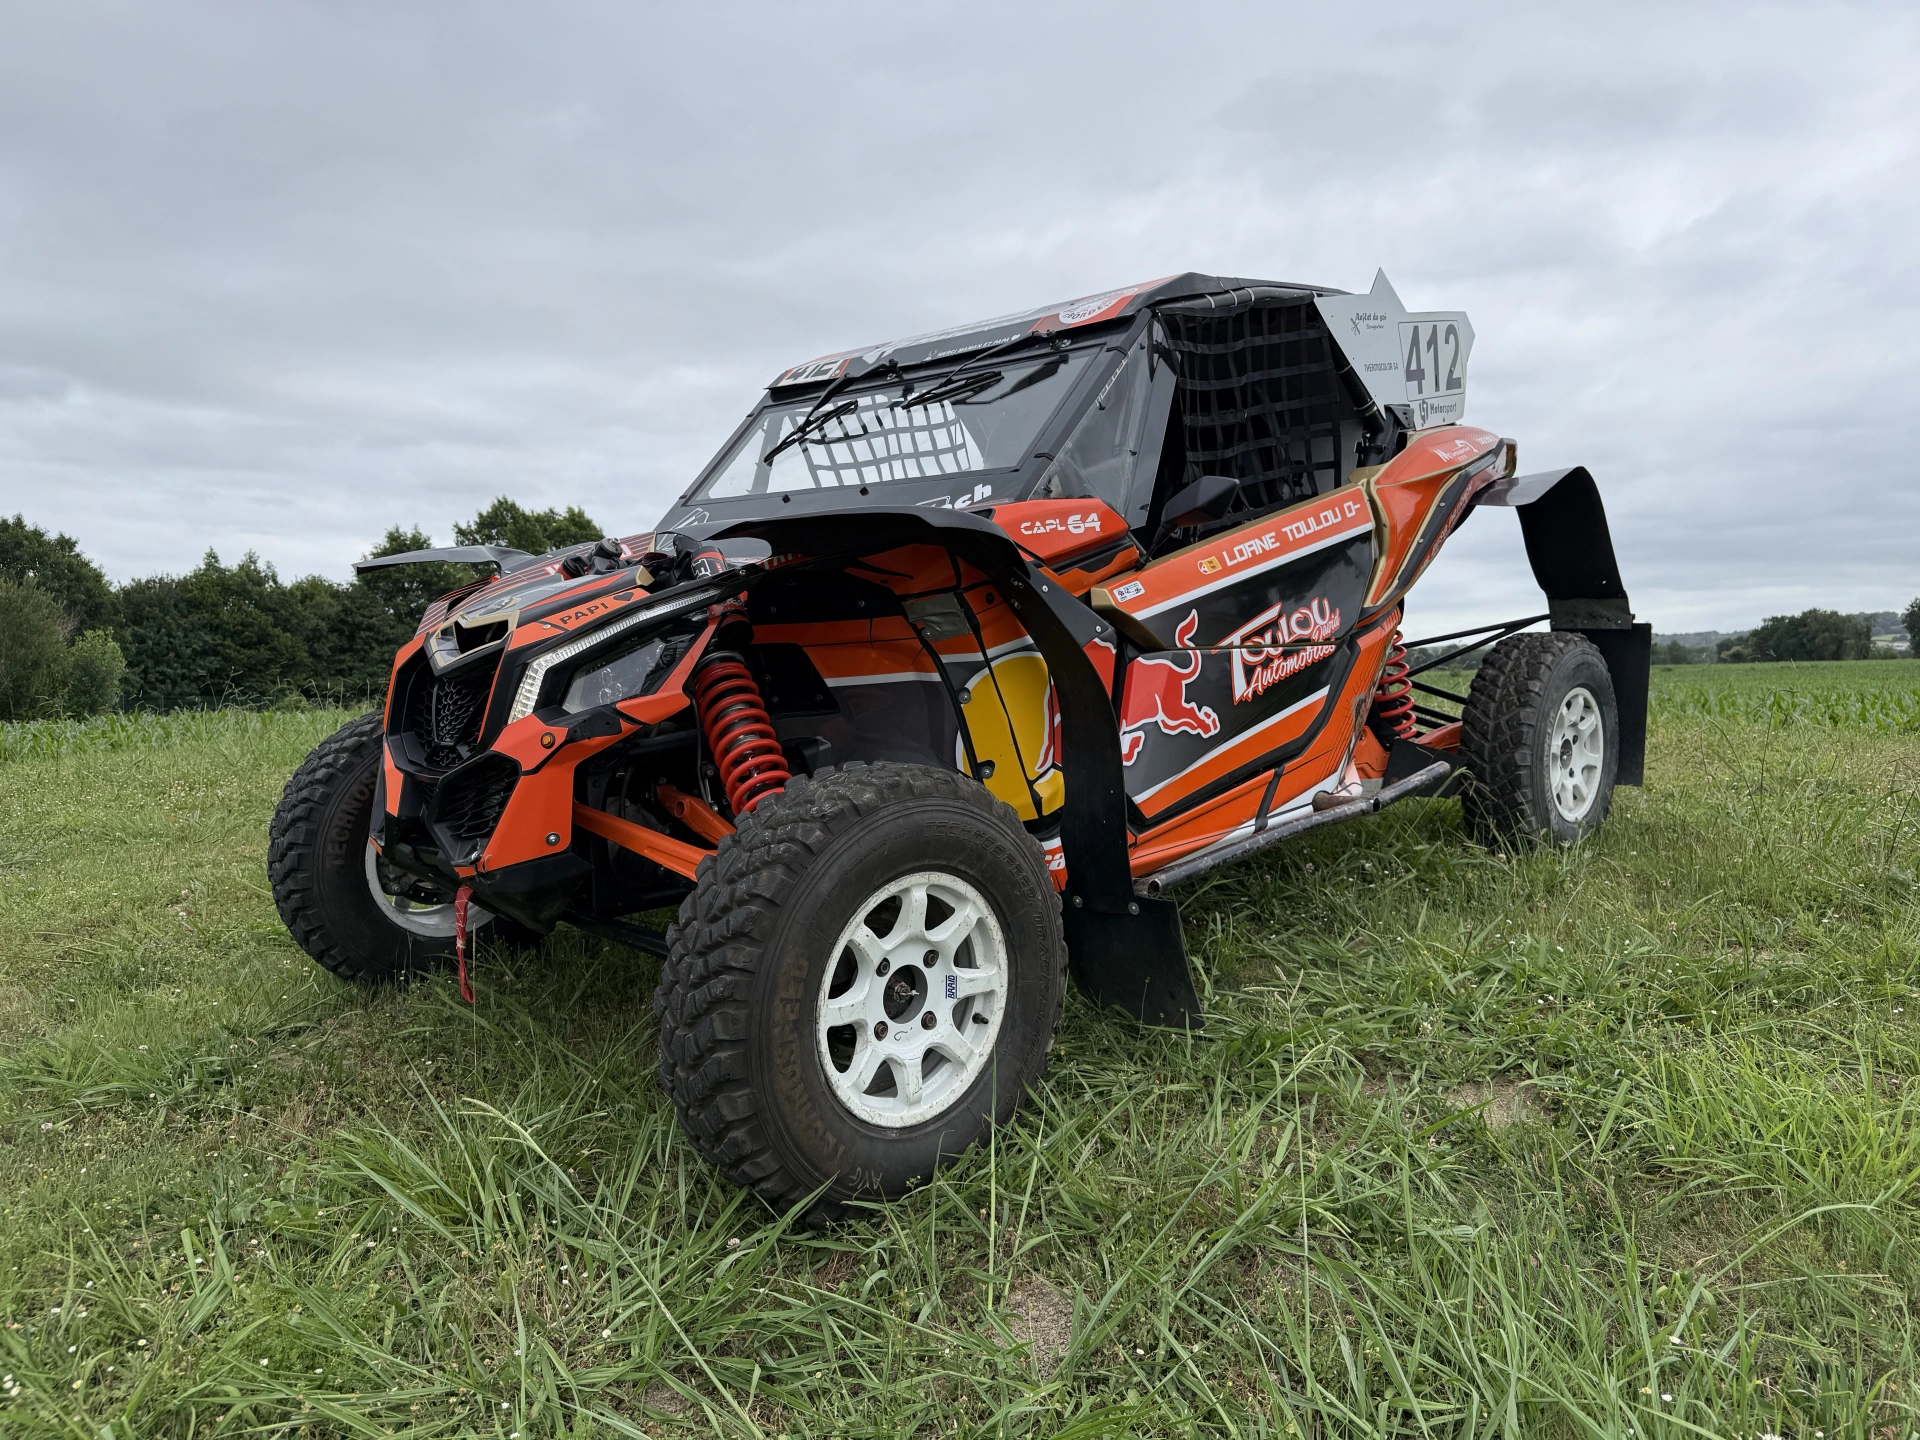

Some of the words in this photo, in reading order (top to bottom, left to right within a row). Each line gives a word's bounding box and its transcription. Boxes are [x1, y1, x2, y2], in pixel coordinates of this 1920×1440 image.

[936, 347, 959, 358] MERCI
[960, 343, 984, 353] MAMAN
[993, 337, 1010, 345] PAPA
[1405, 323, 1462, 395] 412
[1430, 402, 1457, 415] Motorsport
[1020, 519, 1067, 535] CAPL
[1067, 512, 1102, 534] 64
[1281, 507, 1342, 541] TOULOU
[559, 602, 609, 625] PAPI
[1311, 608, 1340, 643] David
[1242, 637, 1337, 702] Automobiles
[947, 974, 956, 1000] BRAID
